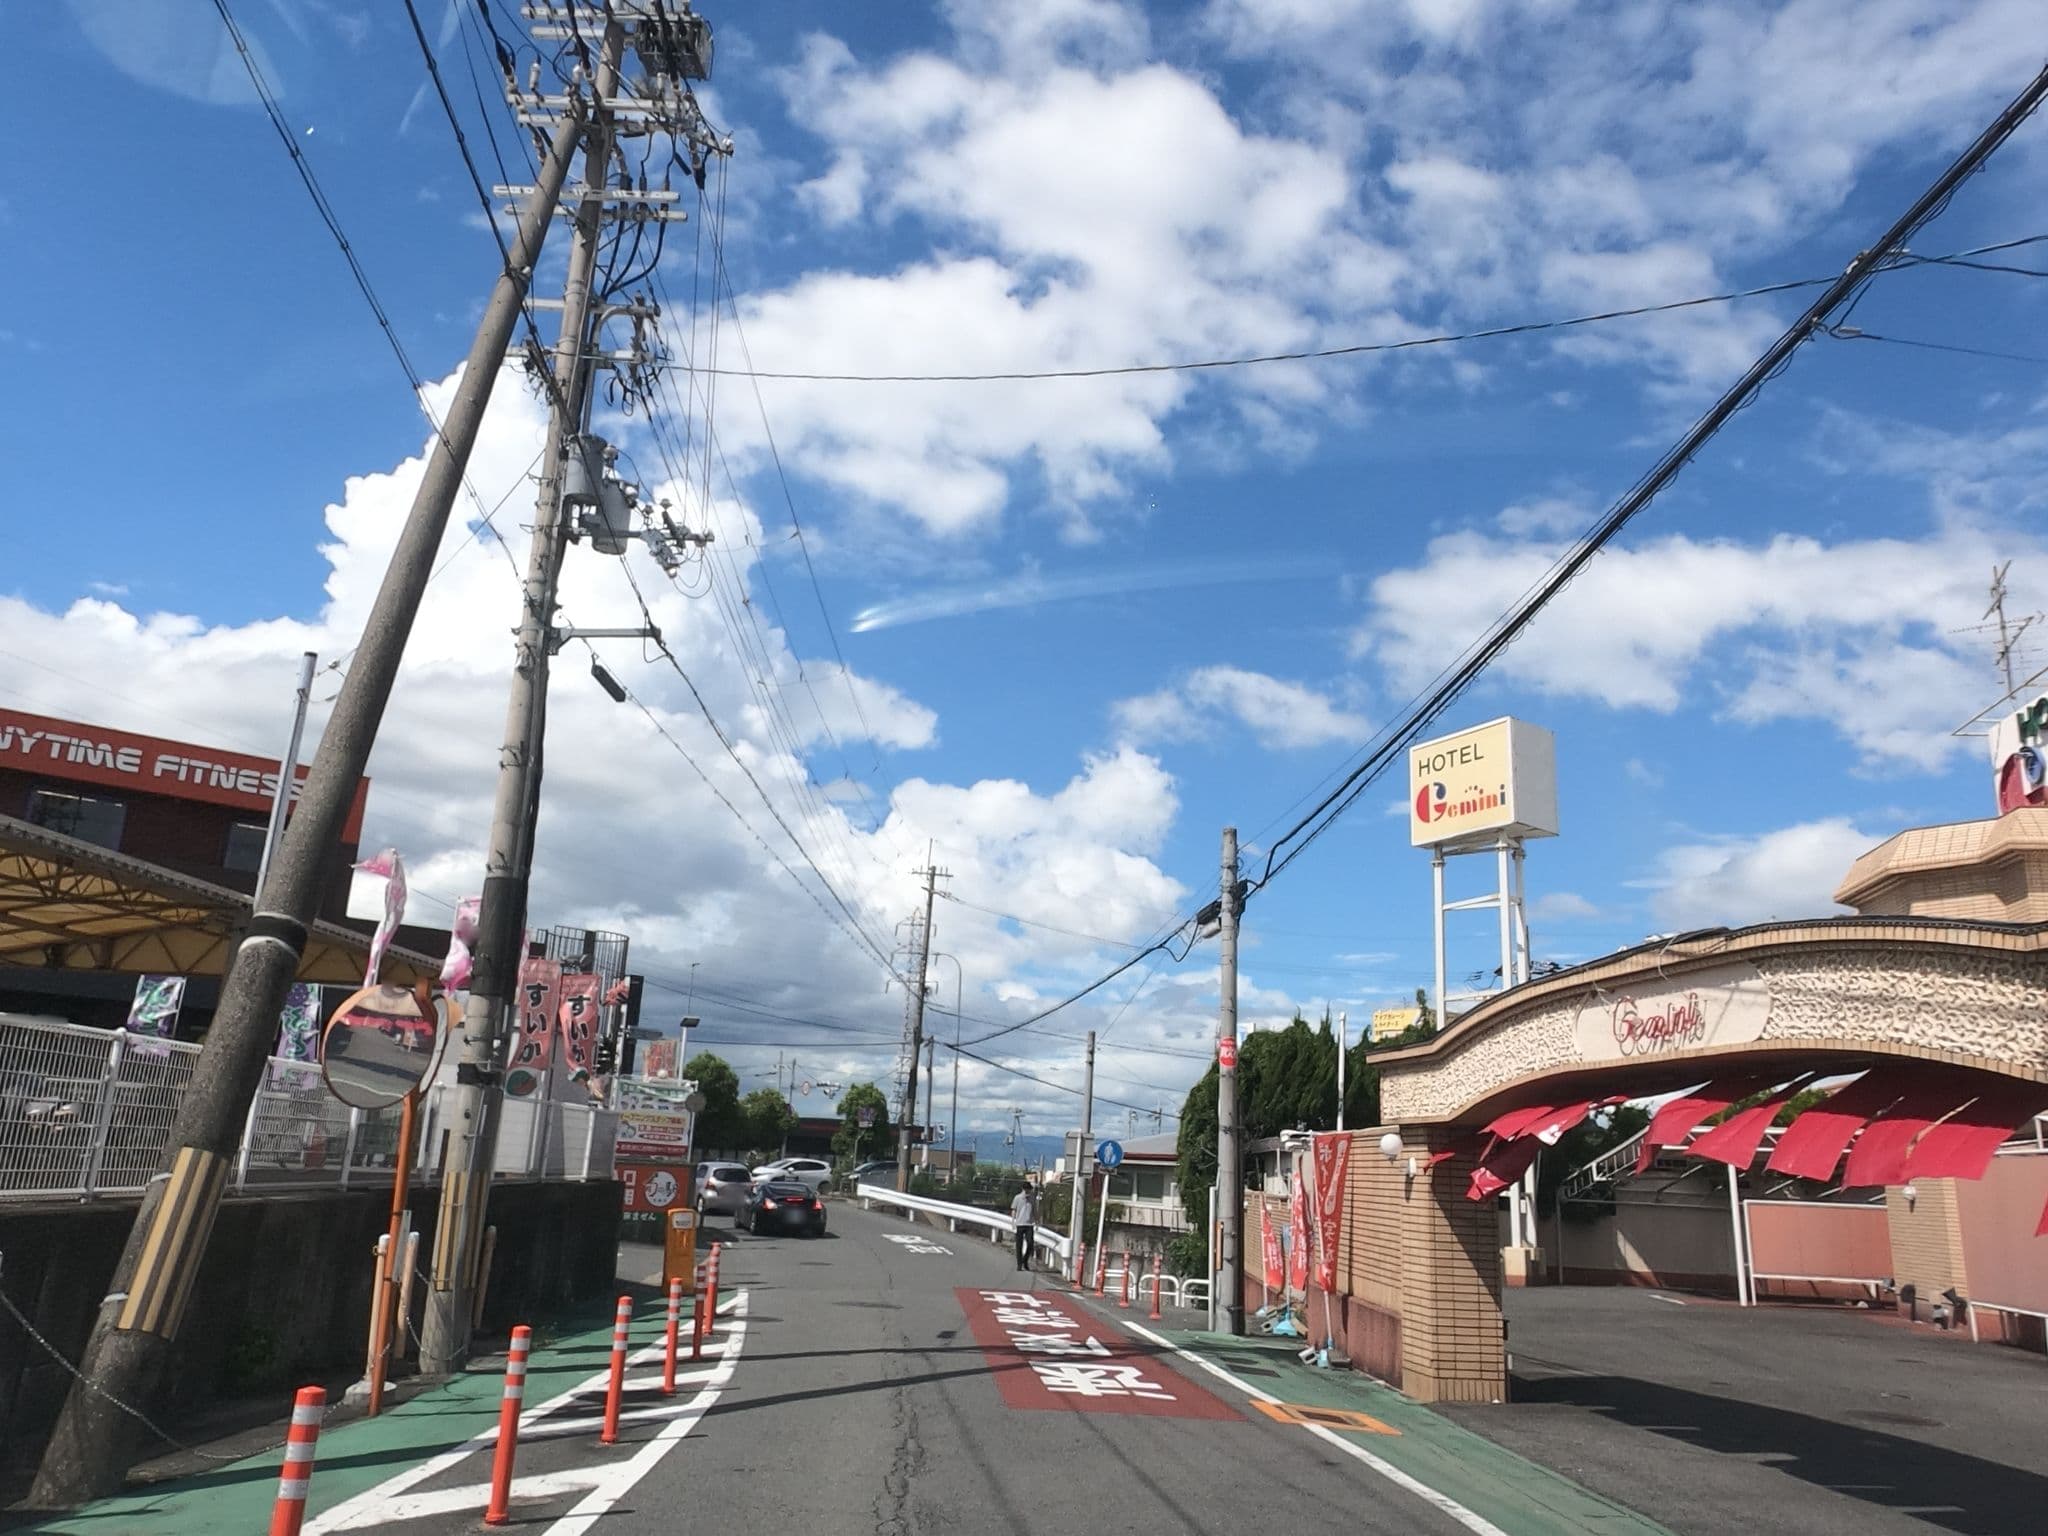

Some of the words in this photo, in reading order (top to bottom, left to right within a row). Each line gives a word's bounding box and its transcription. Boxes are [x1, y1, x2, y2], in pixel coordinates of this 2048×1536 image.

[1418, 743, 1484, 777] HOTEL
[517, 983, 549, 1064] すいか
[566, 994, 591, 1063] すいか
